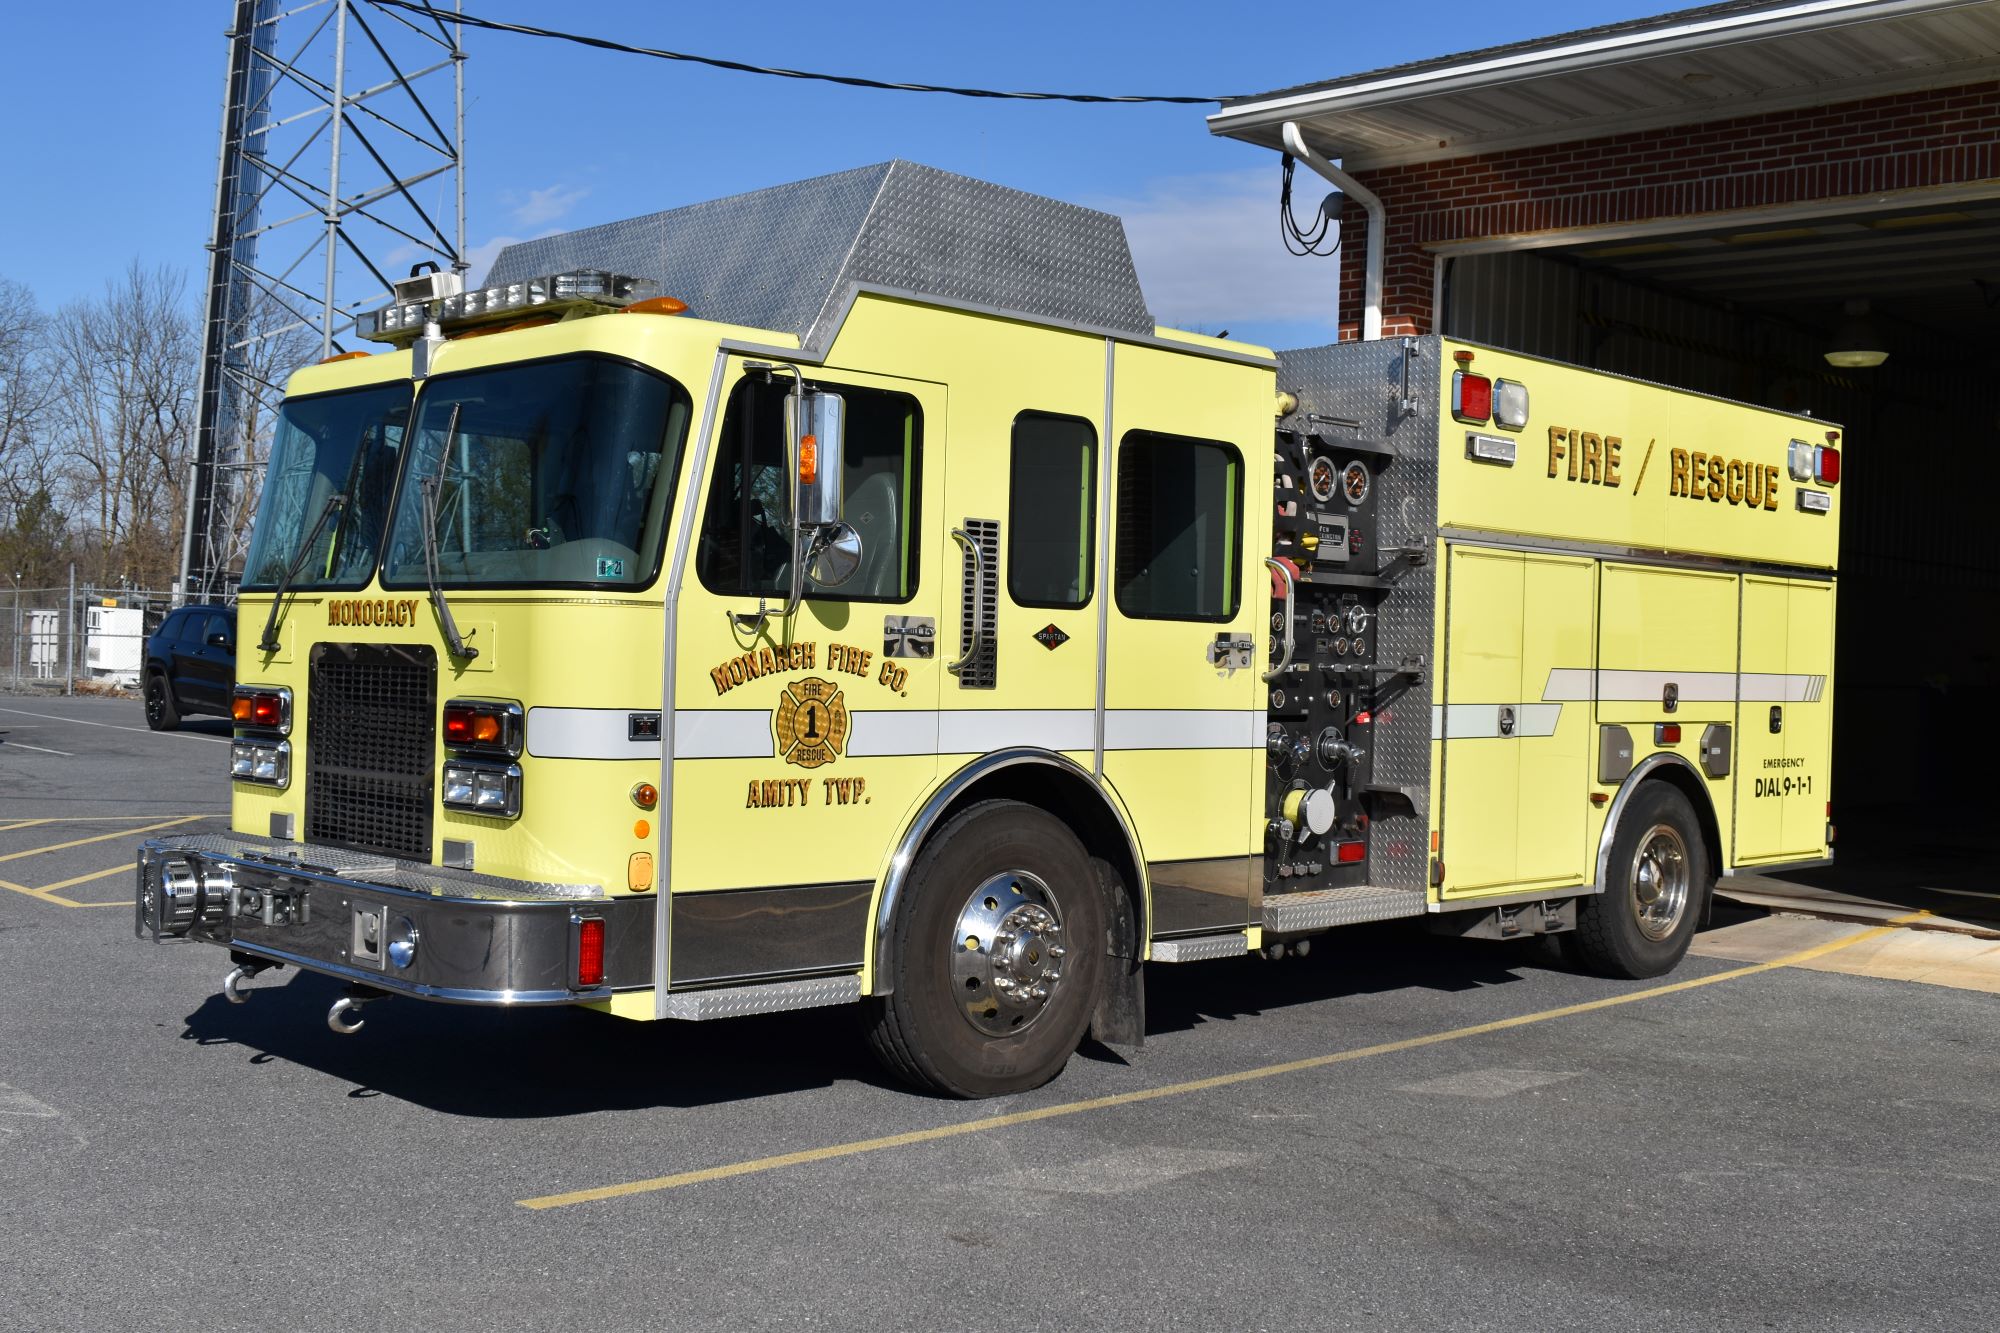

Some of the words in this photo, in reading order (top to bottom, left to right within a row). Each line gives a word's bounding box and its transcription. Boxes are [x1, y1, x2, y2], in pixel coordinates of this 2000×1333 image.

[1547, 425, 1622, 488] FIRE
[1669, 447, 1780, 512] RESCUE
[614, 560, 622, 575] 21
[328, 599, 419, 628] MONOCACY
[1038, 633, 1066, 641] SPARTAN
[710, 641, 816, 696] MONARCH
[827, 642, 873, 678] FIRE
[878, 660, 910, 698] CO.
[803, 683, 823, 696] FIRE
[804, 705, 820, 738] 1
[796, 748, 826, 761] RESCUE
[1763, 757, 1805, 769] EMERGENCY
[746, 778, 812, 809] AMITY
[823, 776, 871, 806] TWP.
[1755, 777, 1781, 798] DIAL
[1783, 775, 1812, 796] 9-1-1
